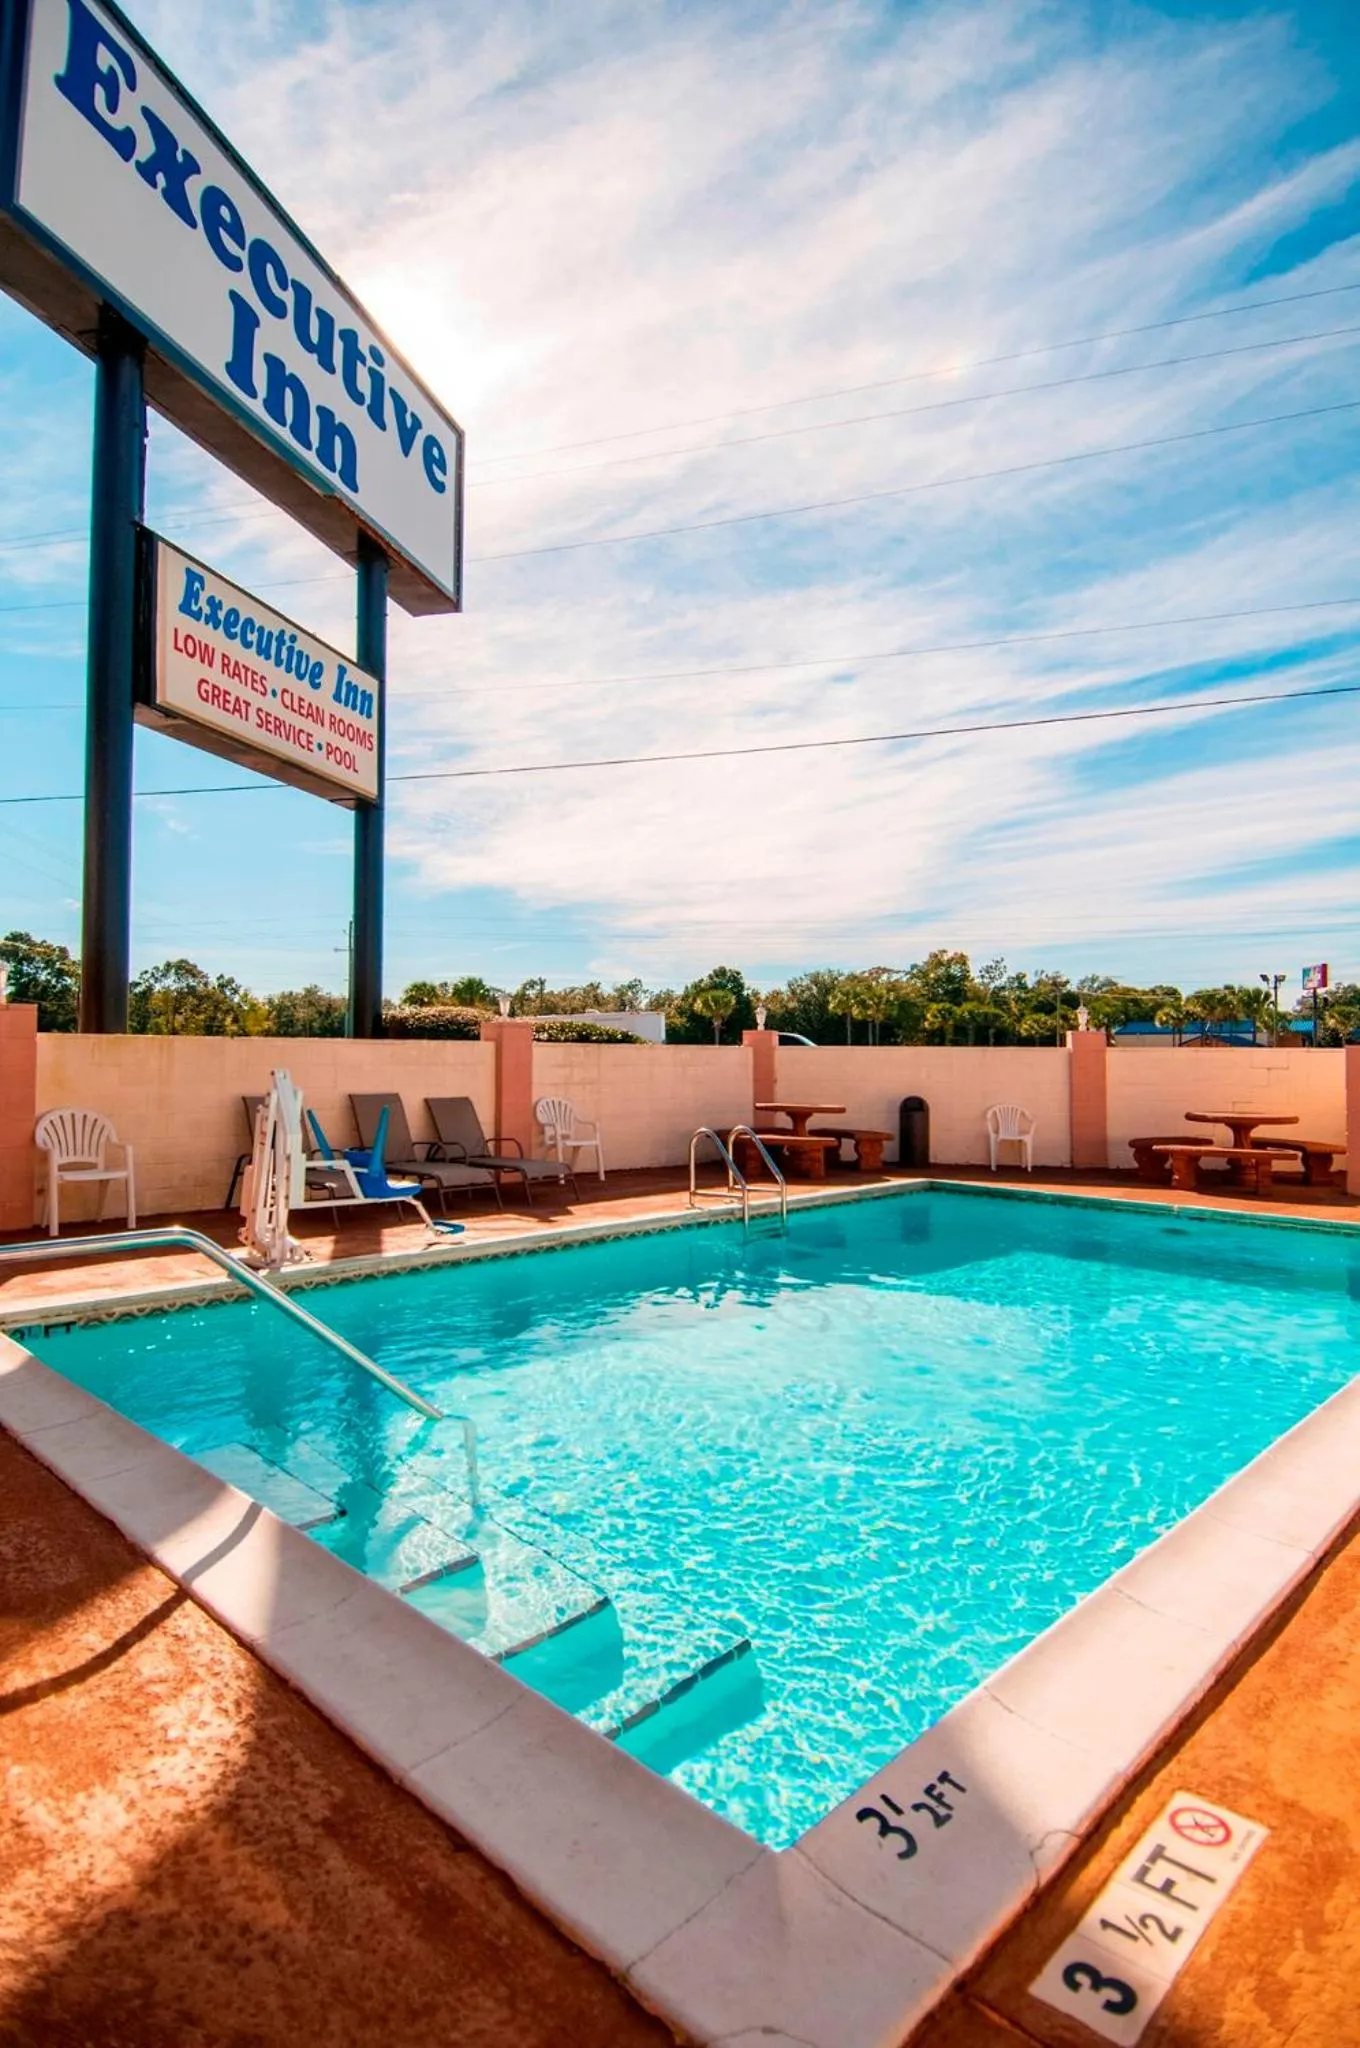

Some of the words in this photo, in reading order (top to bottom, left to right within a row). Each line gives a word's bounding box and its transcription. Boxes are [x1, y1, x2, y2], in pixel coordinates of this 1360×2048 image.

[52, 0, 448, 494] Executive
[224, 289, 360, 494] Inn
[173, 627, 216, 669] LOW
[221, 652, 268, 698] RATES
[280, 687, 325, 727] CLEAN
[328, 713, 375, 751] ROOMS
[178, 567, 324, 690] Executive
[332, 663, 374, 719] Inn
[197, 678, 251, 722] GREAT
[256, 706, 314, 753] SERVICE
[325, 742, 359, 774] POOL
[1062, 1961, 1139, 2017] 3
[1130, 1843, 1217, 1912] FT
